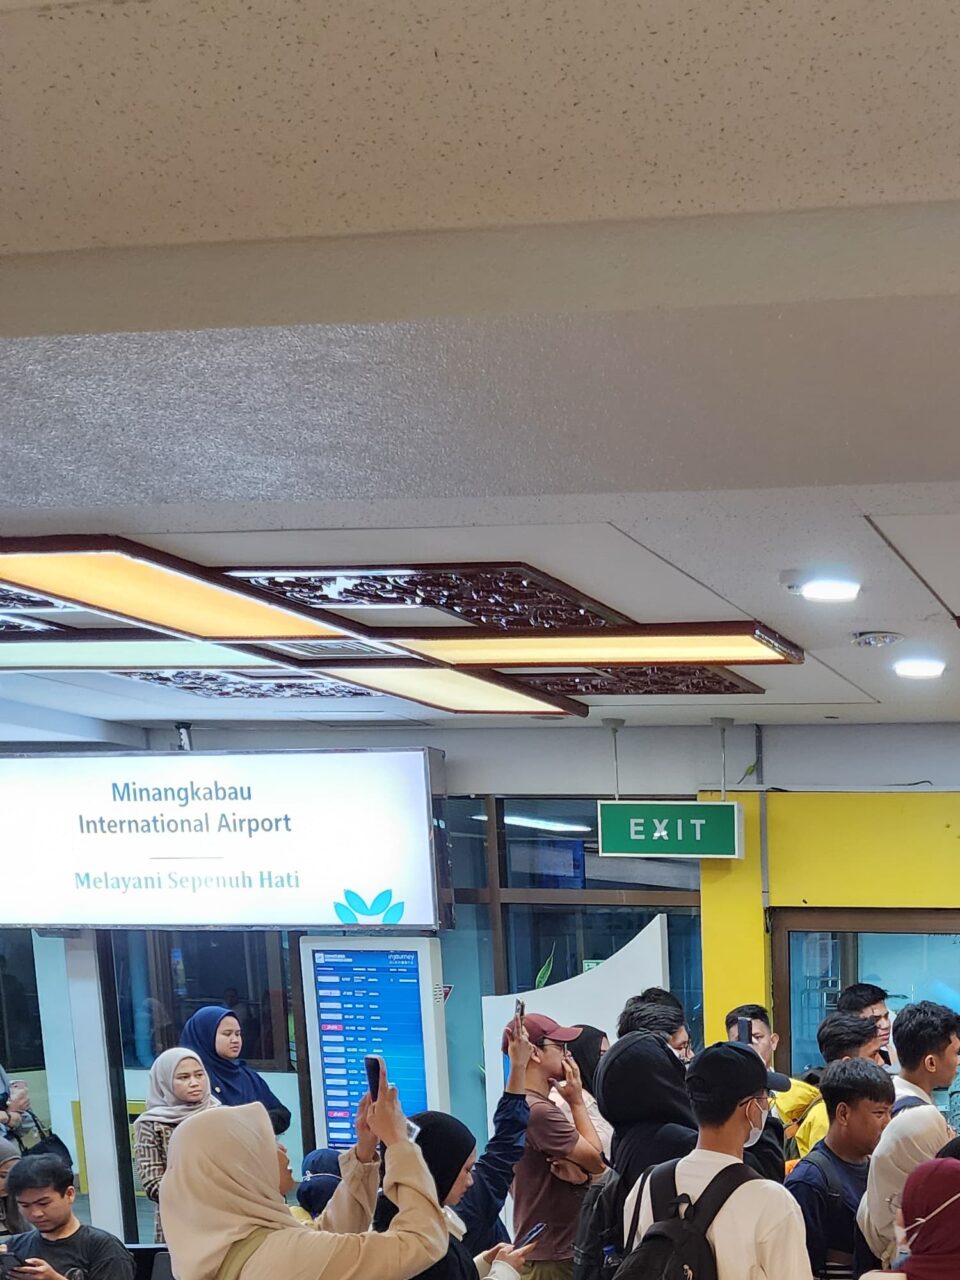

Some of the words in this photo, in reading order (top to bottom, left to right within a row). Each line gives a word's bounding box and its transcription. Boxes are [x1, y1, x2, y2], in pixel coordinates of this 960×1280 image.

[111, 780, 252, 807] Minangkabau
[78, 813, 210, 834] International
[217, 813, 292, 838] Airport
[629, 818, 706, 841] EXIT
[74, 872, 162, 894] Melayani
[168, 872, 253, 893] Sepenuh
[259, 871, 300, 889] Hati
